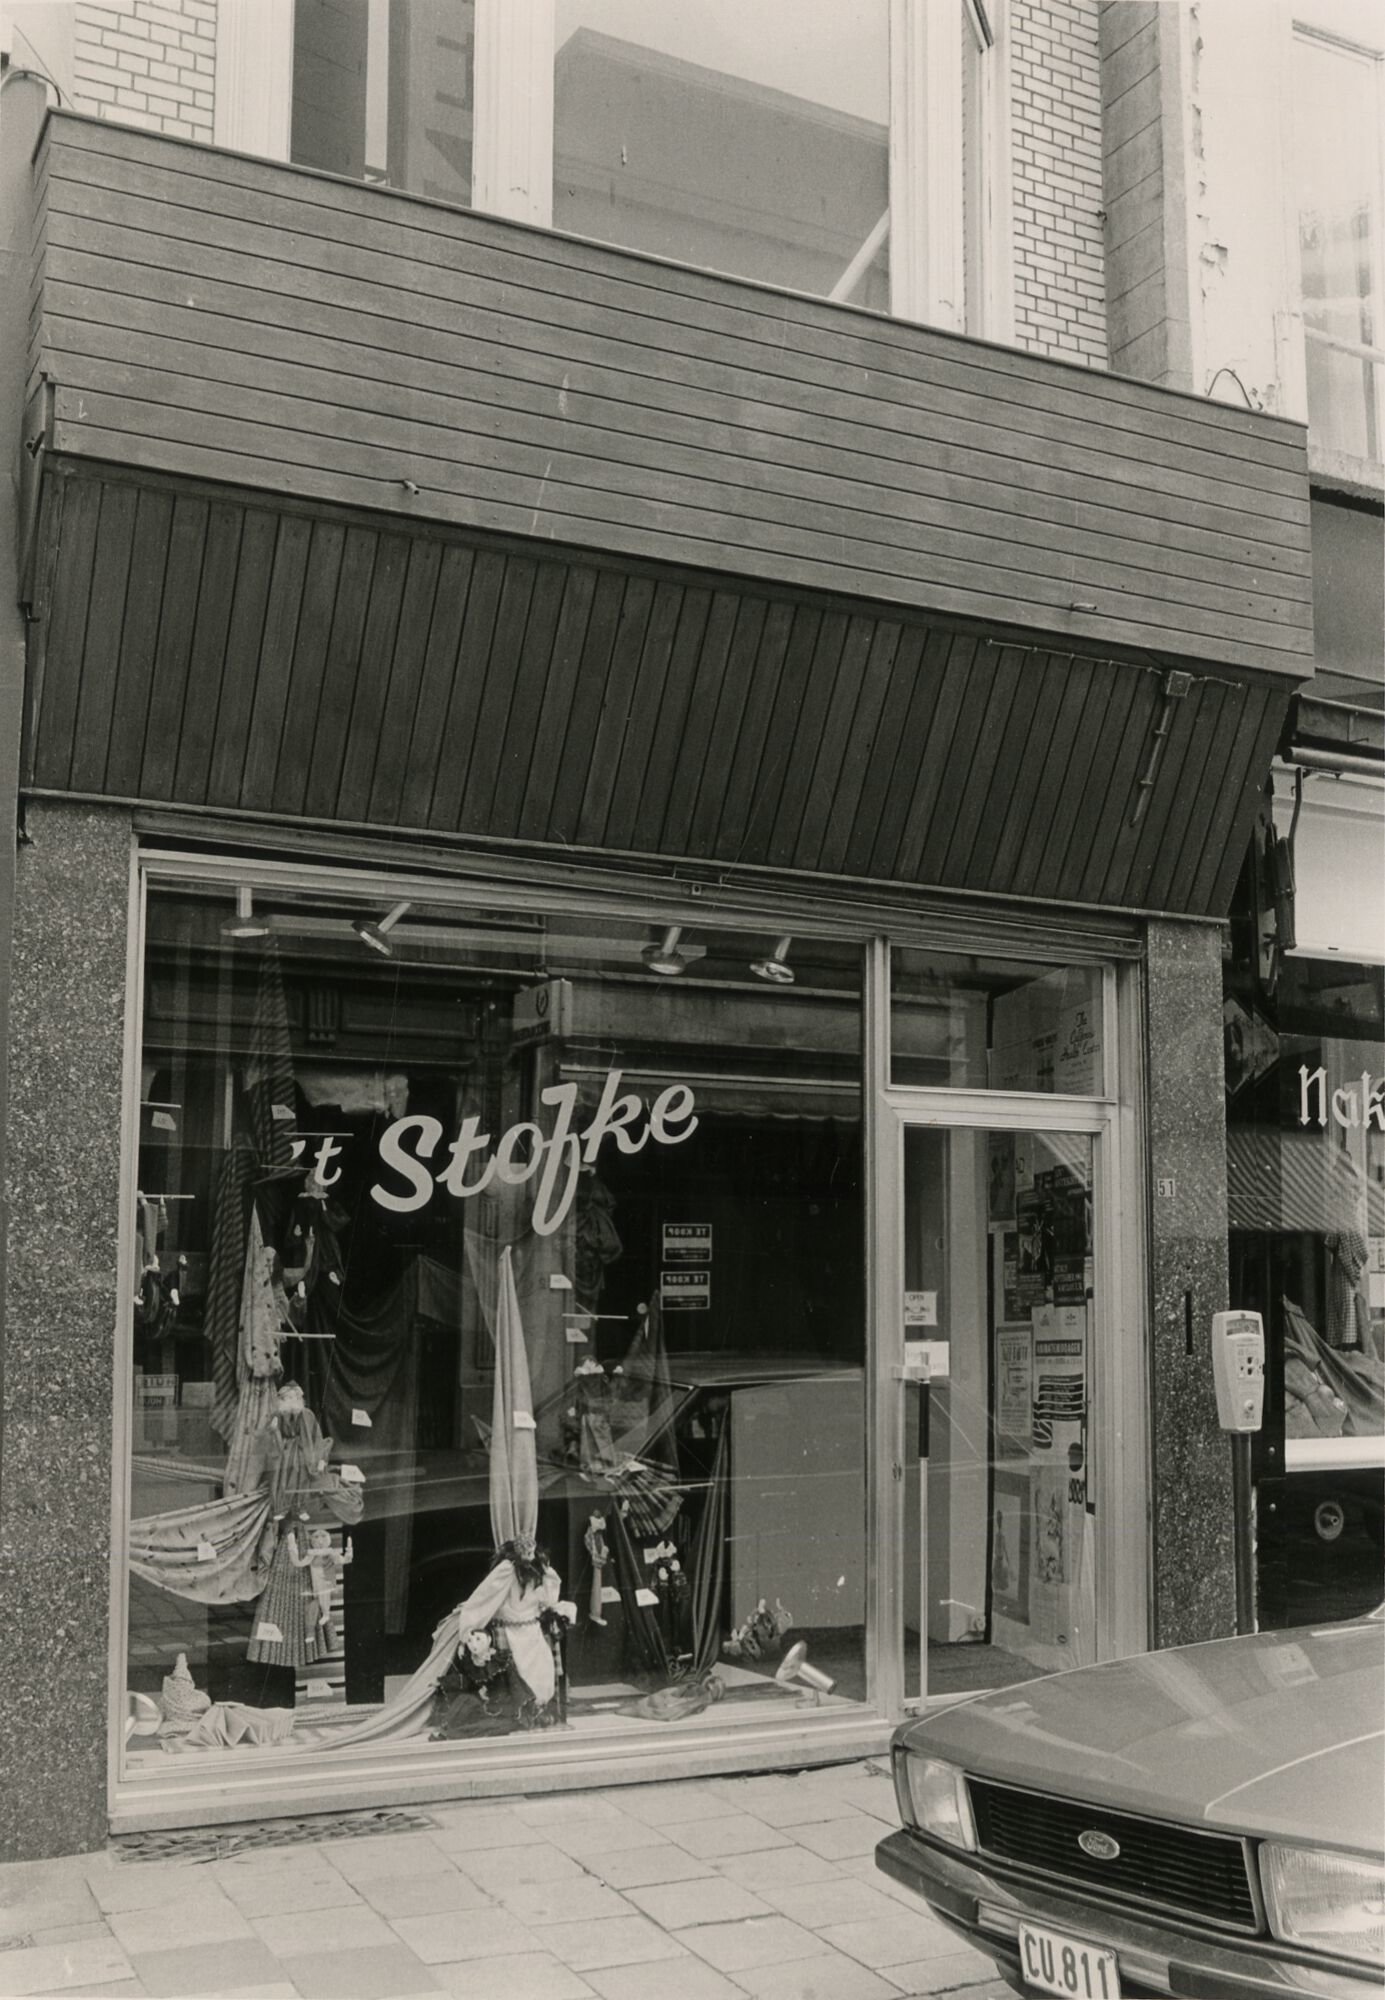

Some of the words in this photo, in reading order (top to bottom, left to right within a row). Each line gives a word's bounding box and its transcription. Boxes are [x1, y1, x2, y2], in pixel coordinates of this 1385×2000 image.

[370, 1070, 699, 1236] Stofke
[1159, 1180, 1174, 1196] 51
[1024, 1932, 1109, 2000] CU.811
